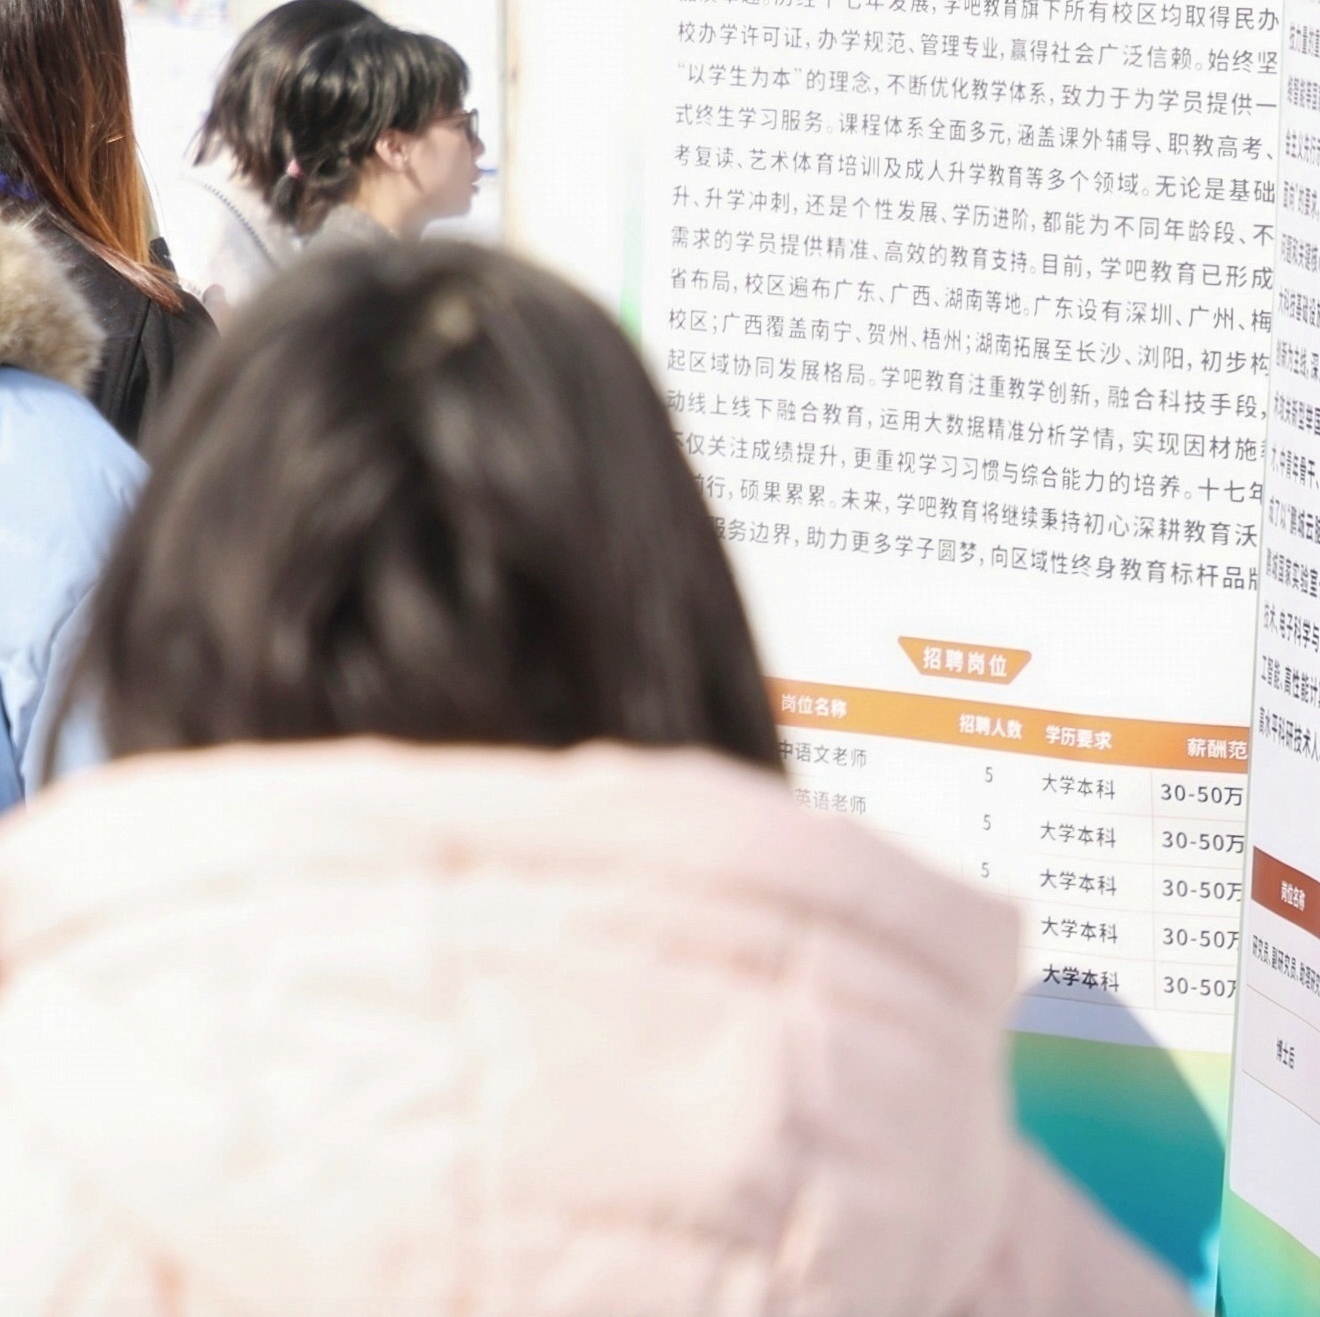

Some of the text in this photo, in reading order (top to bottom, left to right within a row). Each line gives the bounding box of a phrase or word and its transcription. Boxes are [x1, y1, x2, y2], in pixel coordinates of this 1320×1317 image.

[667, 389, 1266, 462] 动线上线下融合教育，运用大数据精准分析学情，实现因材施
[921, 645, 1009, 679] 招聘岗位
[781, 693, 848, 719] 岗位名称
[959, 713, 1022, 741] 招聘人数
[1045, 724, 1113, 750] 学历要求
[1186, 737, 1249, 761] 薪酬范
[984, 766, 994, 784] 5
[1041, 772, 1116, 801] 大学本科
[794, 787, 867, 815] 英语老师
[1160, 783, 1244, 807] 30-50万
[982, 814, 992, 831] 5
[1039, 820, 1117, 849] 大学本科
[1161, 830, 1245, 854] 30-50万
[980, 861, 990, 879] 5
[1039, 868, 1117, 897] 大学本科
[1162, 878, 1243, 903] 30-50万
[1041, 915, 1118, 945] 大学本科
[1042, 963, 1120, 993] 大学本科
[1276, 1037, 1296, 1070] 博士后
